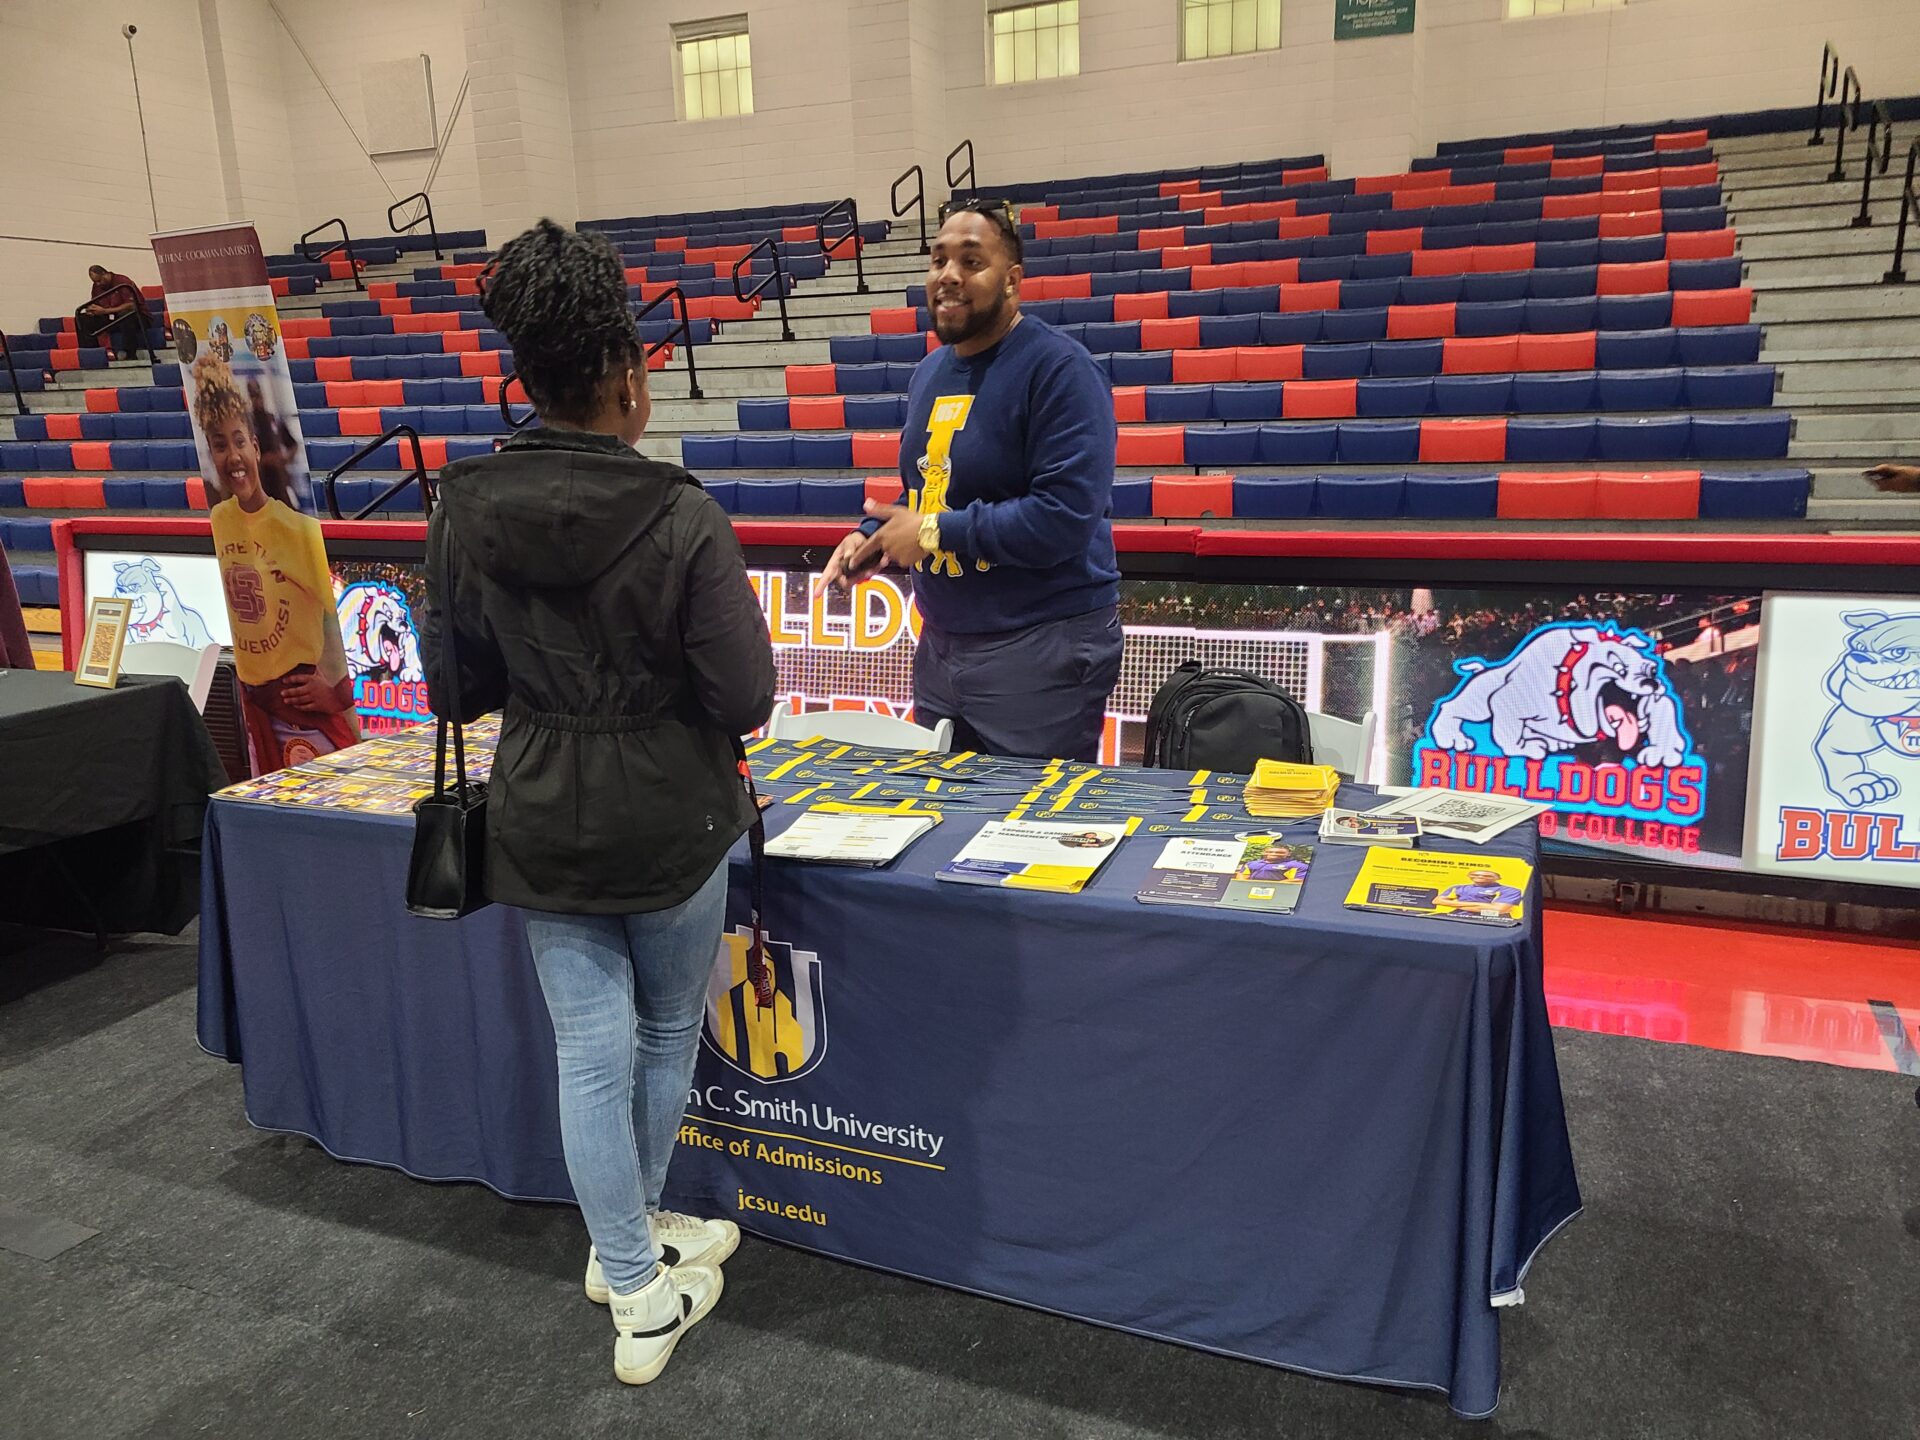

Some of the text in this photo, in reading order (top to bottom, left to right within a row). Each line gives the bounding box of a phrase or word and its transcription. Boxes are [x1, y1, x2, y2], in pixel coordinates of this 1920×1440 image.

[1419, 748, 1701, 816] BULLDOGS
[1567, 813, 1700, 854] COLLEGE
[1776, 805, 1920, 862] BUL
[705, 1085, 731, 1113] C.
[734, 1089, 808, 1127] Smith
[812, 1103, 944, 1158] University
[729, 1139, 751, 1158] of
[755, 1143, 883, 1185] Admissions
[737, 1188, 828, 1226] jcsu.edu
